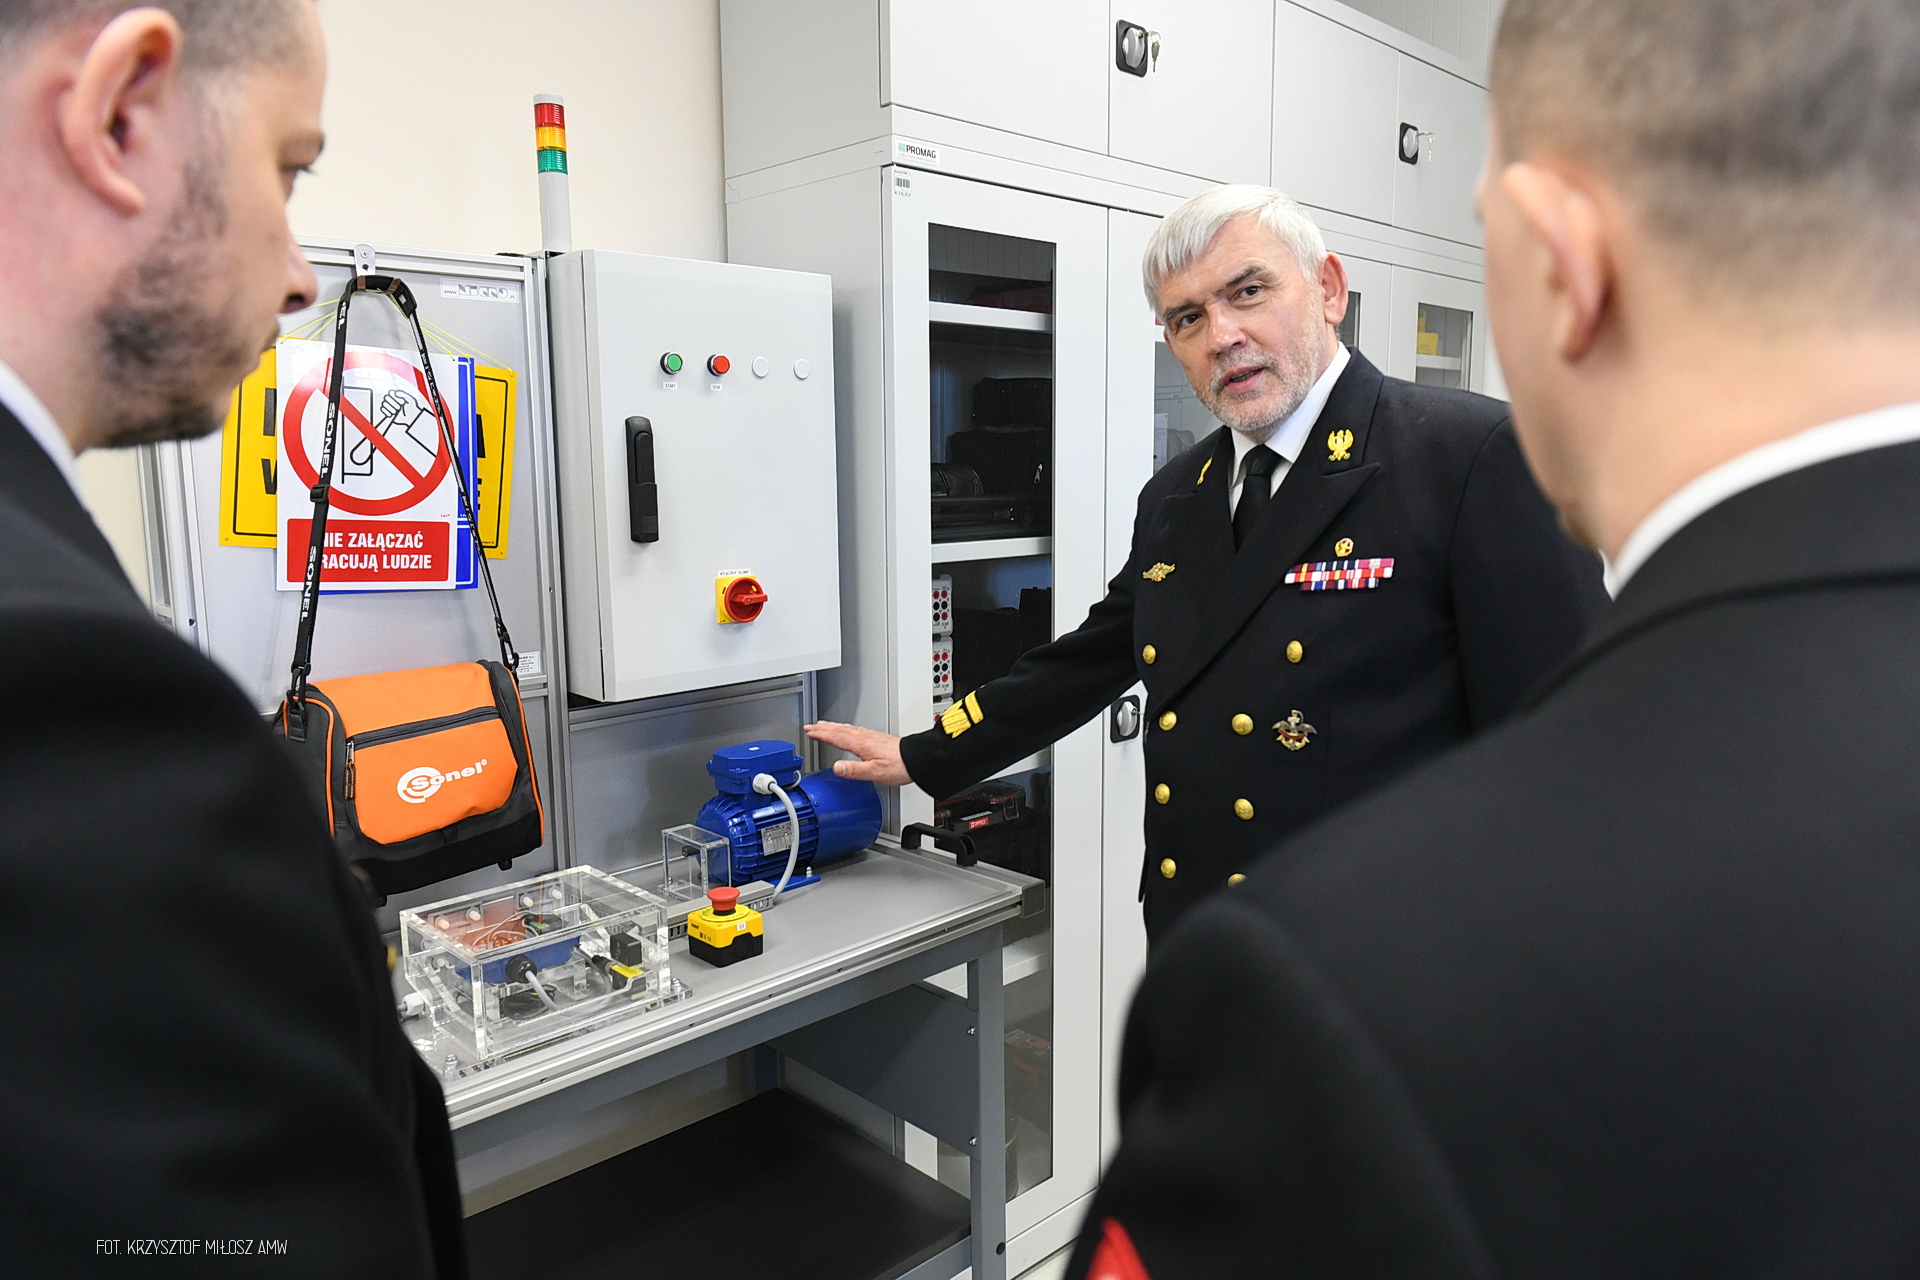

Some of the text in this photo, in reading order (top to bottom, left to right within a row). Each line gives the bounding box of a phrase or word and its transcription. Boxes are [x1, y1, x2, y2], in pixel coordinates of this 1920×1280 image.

[905, 144, 937, 159] PROMAG
[320, 402, 336, 479] SONEL
[347, 530, 424, 552] ZAŁĄCZAĆ
[320, 553, 432, 573] RACUJĄ LUDZIE
[300, 545, 317, 623] SONEL
